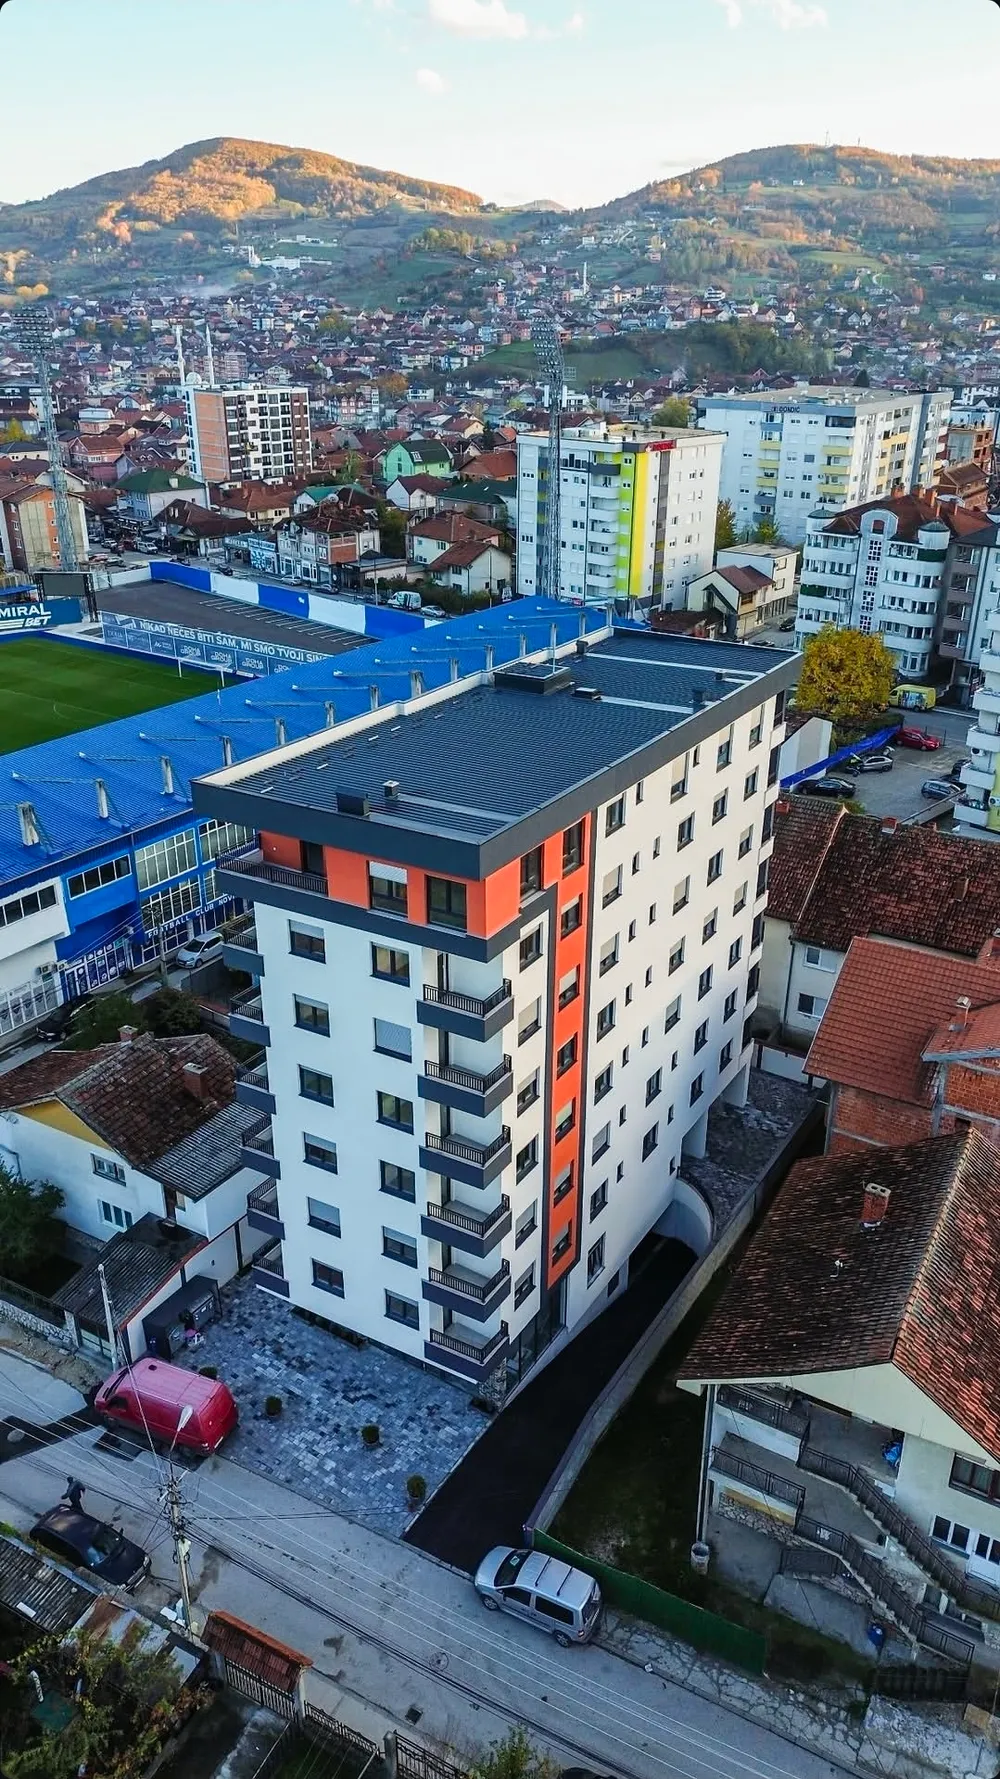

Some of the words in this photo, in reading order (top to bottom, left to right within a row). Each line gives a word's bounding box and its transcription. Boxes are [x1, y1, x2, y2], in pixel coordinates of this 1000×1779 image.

[24, 616, 52, 627] BET
[140, 620, 166, 634] NIKAD
[197, 632, 214, 644] BITI
[216, 635, 239, 649] SAM,
[241, 641, 253, 651] MI
[253, 643, 275, 655] SMO
[277, 648, 304, 662] TVOJI
[306, 653, 328, 663] SIN
[195, 903, 215, 917] CLUB
